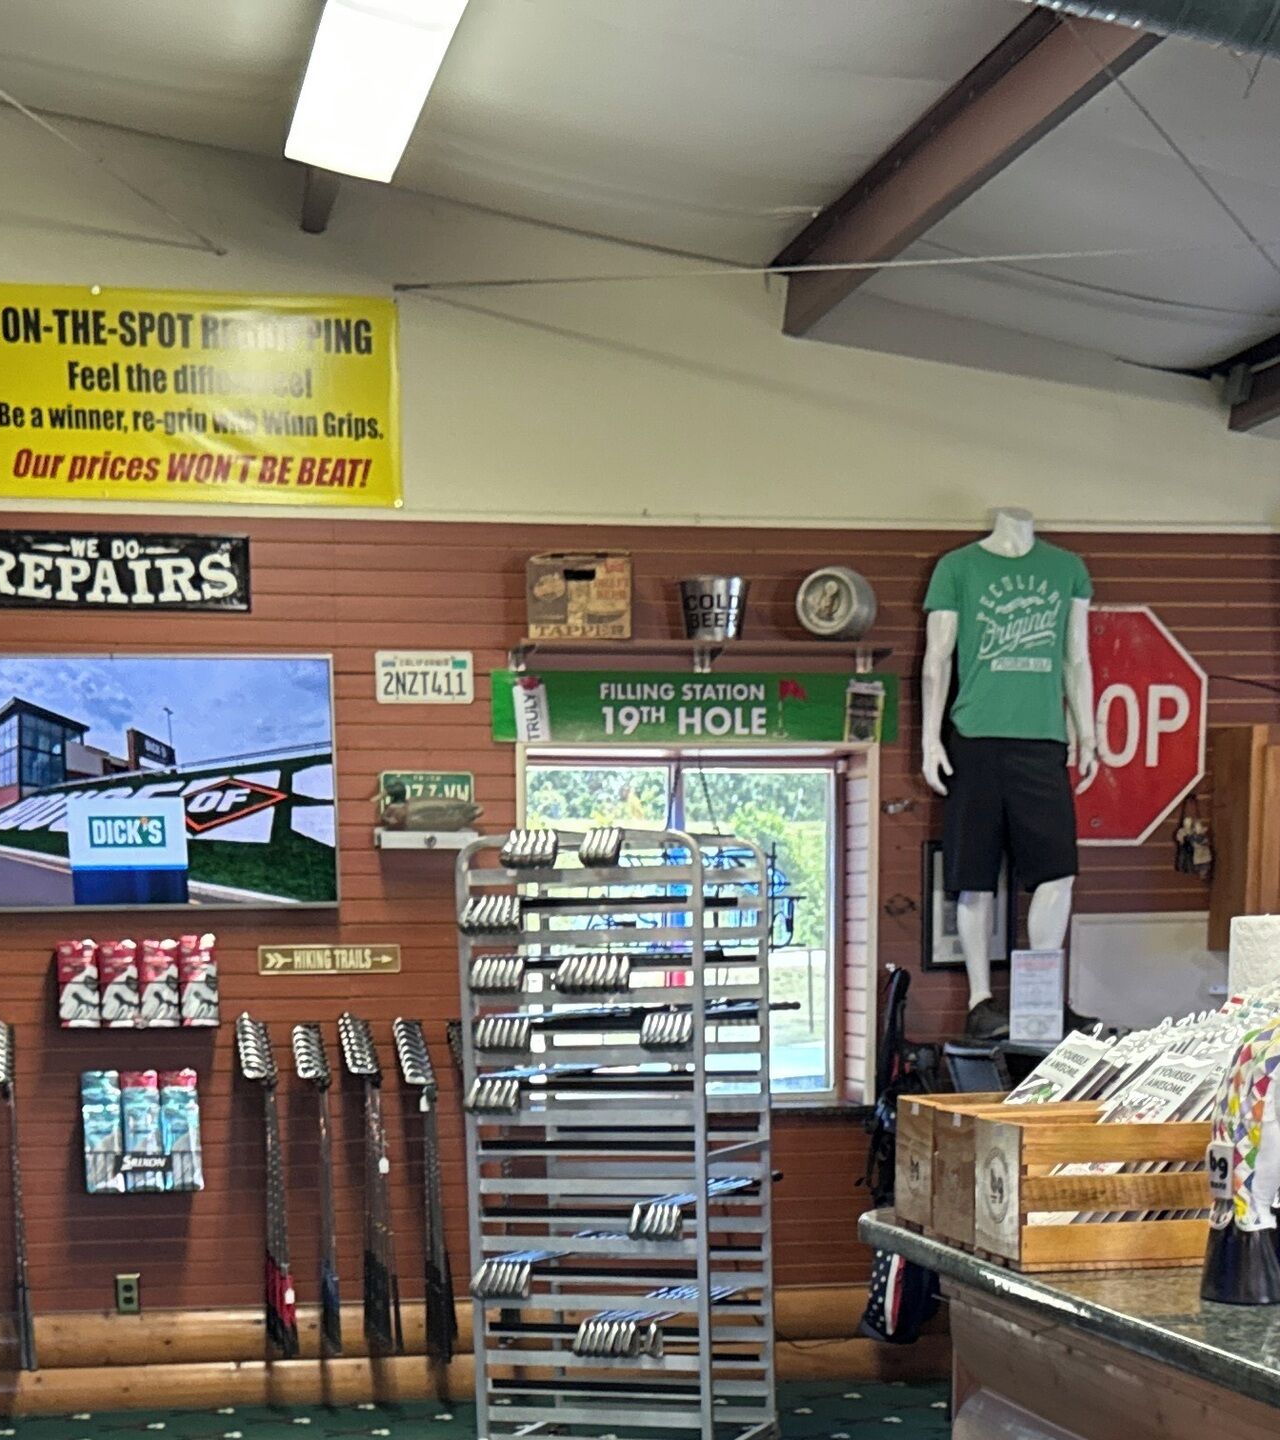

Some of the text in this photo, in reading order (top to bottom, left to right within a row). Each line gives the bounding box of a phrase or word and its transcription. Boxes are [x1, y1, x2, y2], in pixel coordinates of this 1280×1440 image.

[1, 306, 193, 349] ON-THE-SPOT
[67, 361, 120, 391] Feel
[126, 362, 168, 393] the
[31, 407, 43, 428] a
[48, 404, 128, 433] winner,
[323, 411, 384, 442] Grips.
[13, 448, 372, 489] Our prices WON'T BE BEAT!
[70, 538, 141, 560] WE DO
[687, 593, 741, 612] COLD
[689, 610, 739, 629] BEER
[976, 600, 1062, 652] Original
[383, 671, 468, 697] 2NZT411
[599, 682, 766, 702] FILLING STATION
[525, 692, 542, 741] TRULY
[600, 706, 768, 736] 19TH HOLE
[1067, 683, 1191, 768] OP
[186, 787, 254, 814] OF
[92, 818, 164, 845] DICK'S
[293, 950, 372, 970] HIKING TRAILS
[120, 1154, 168, 1172] SRIXON
[1208, 1150, 1229, 1180] bg
